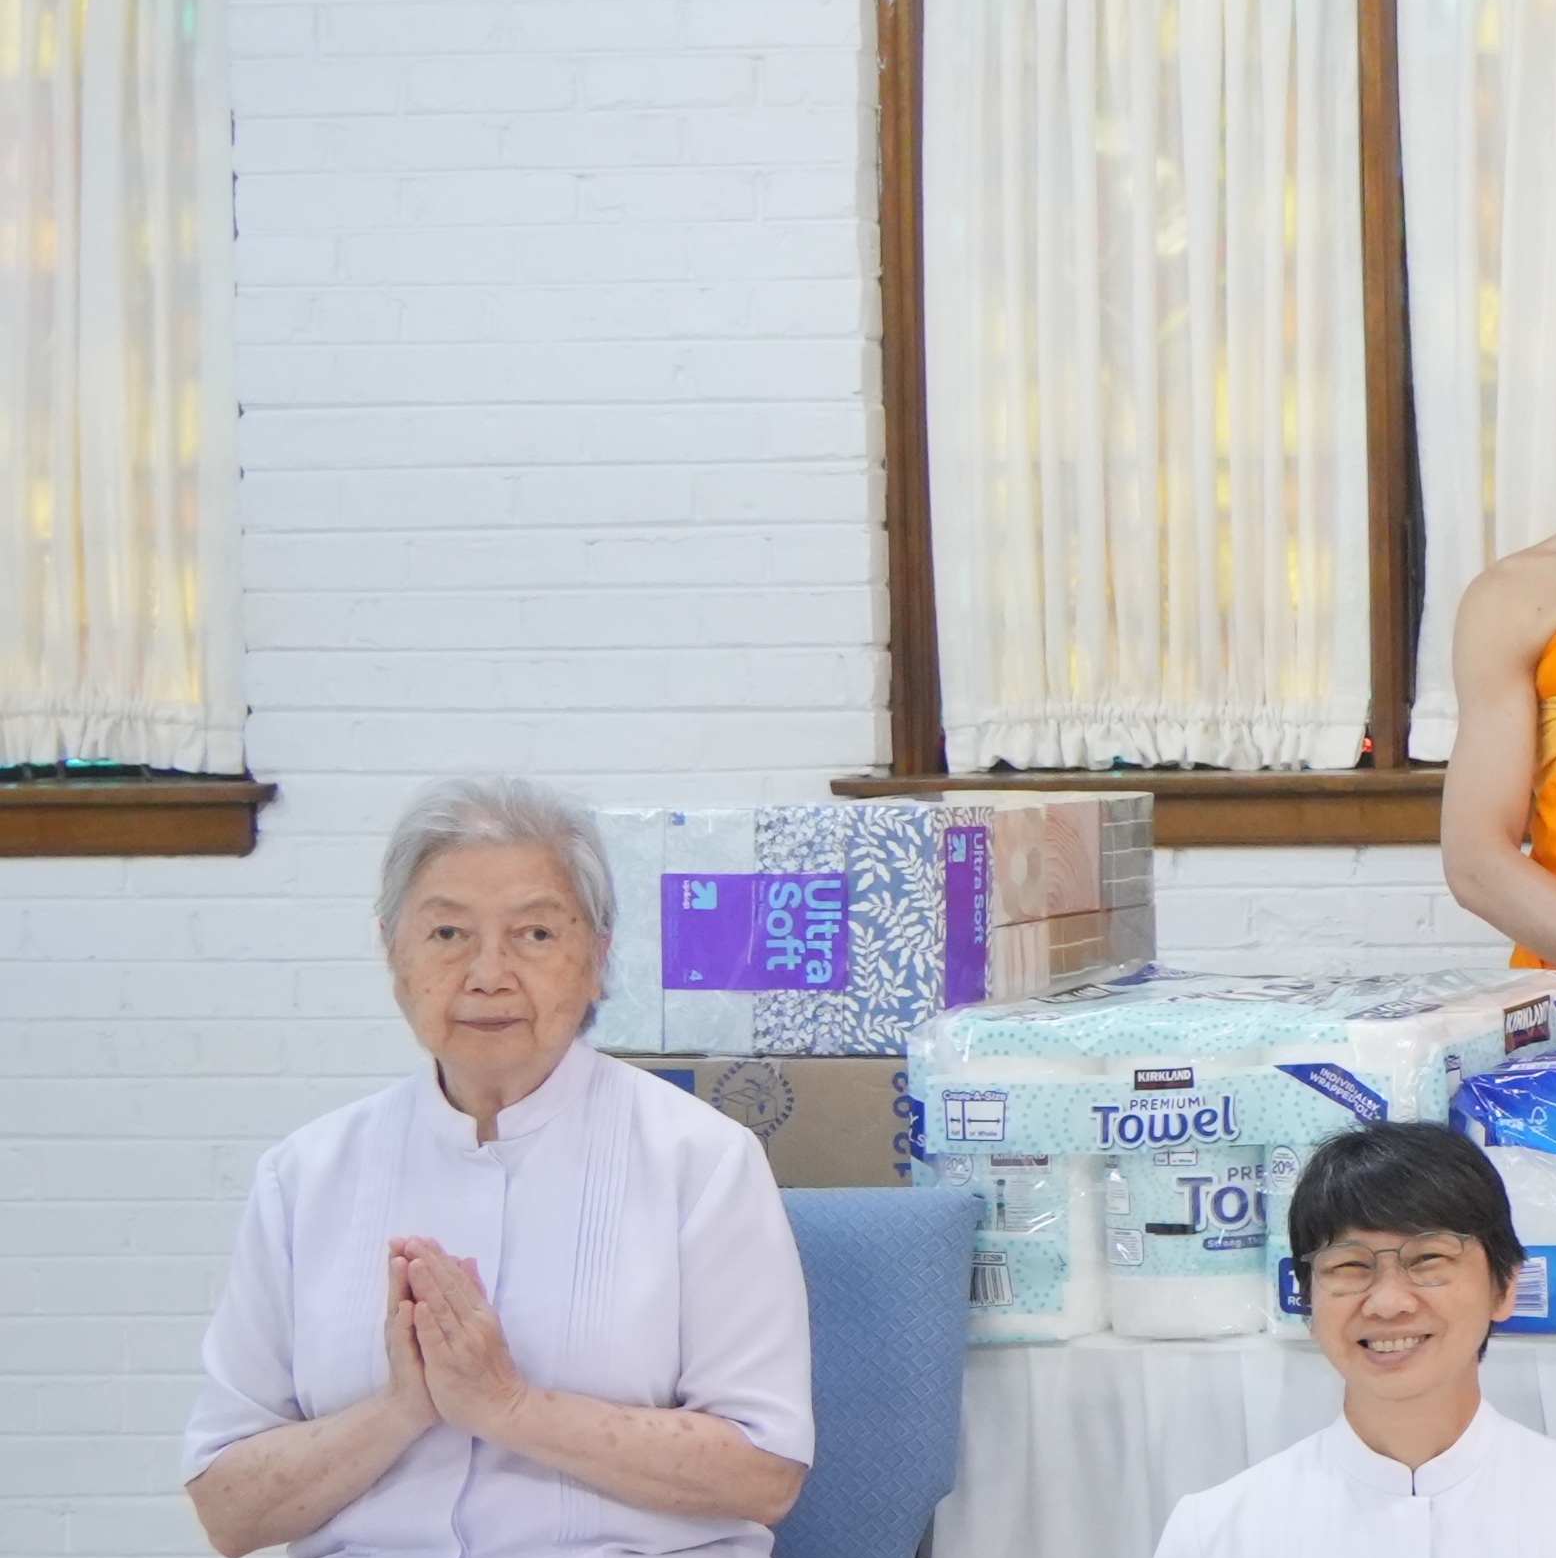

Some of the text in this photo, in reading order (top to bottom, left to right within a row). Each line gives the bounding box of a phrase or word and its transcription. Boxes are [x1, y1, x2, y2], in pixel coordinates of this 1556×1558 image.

[682, 879, 691, 910] up&up
[973, 832, 984, 945] Ultra Soft
[765, 881, 806, 971] Soft
[804, 879, 842, 984] Ultra
[689, 969, 703, 981] 4
[1137, 1070, 1192, 1083] KIRKLAND
[1130, 1096, 1201, 1111] PREMIUM
[1091, 1102, 1236, 1144] Towel
